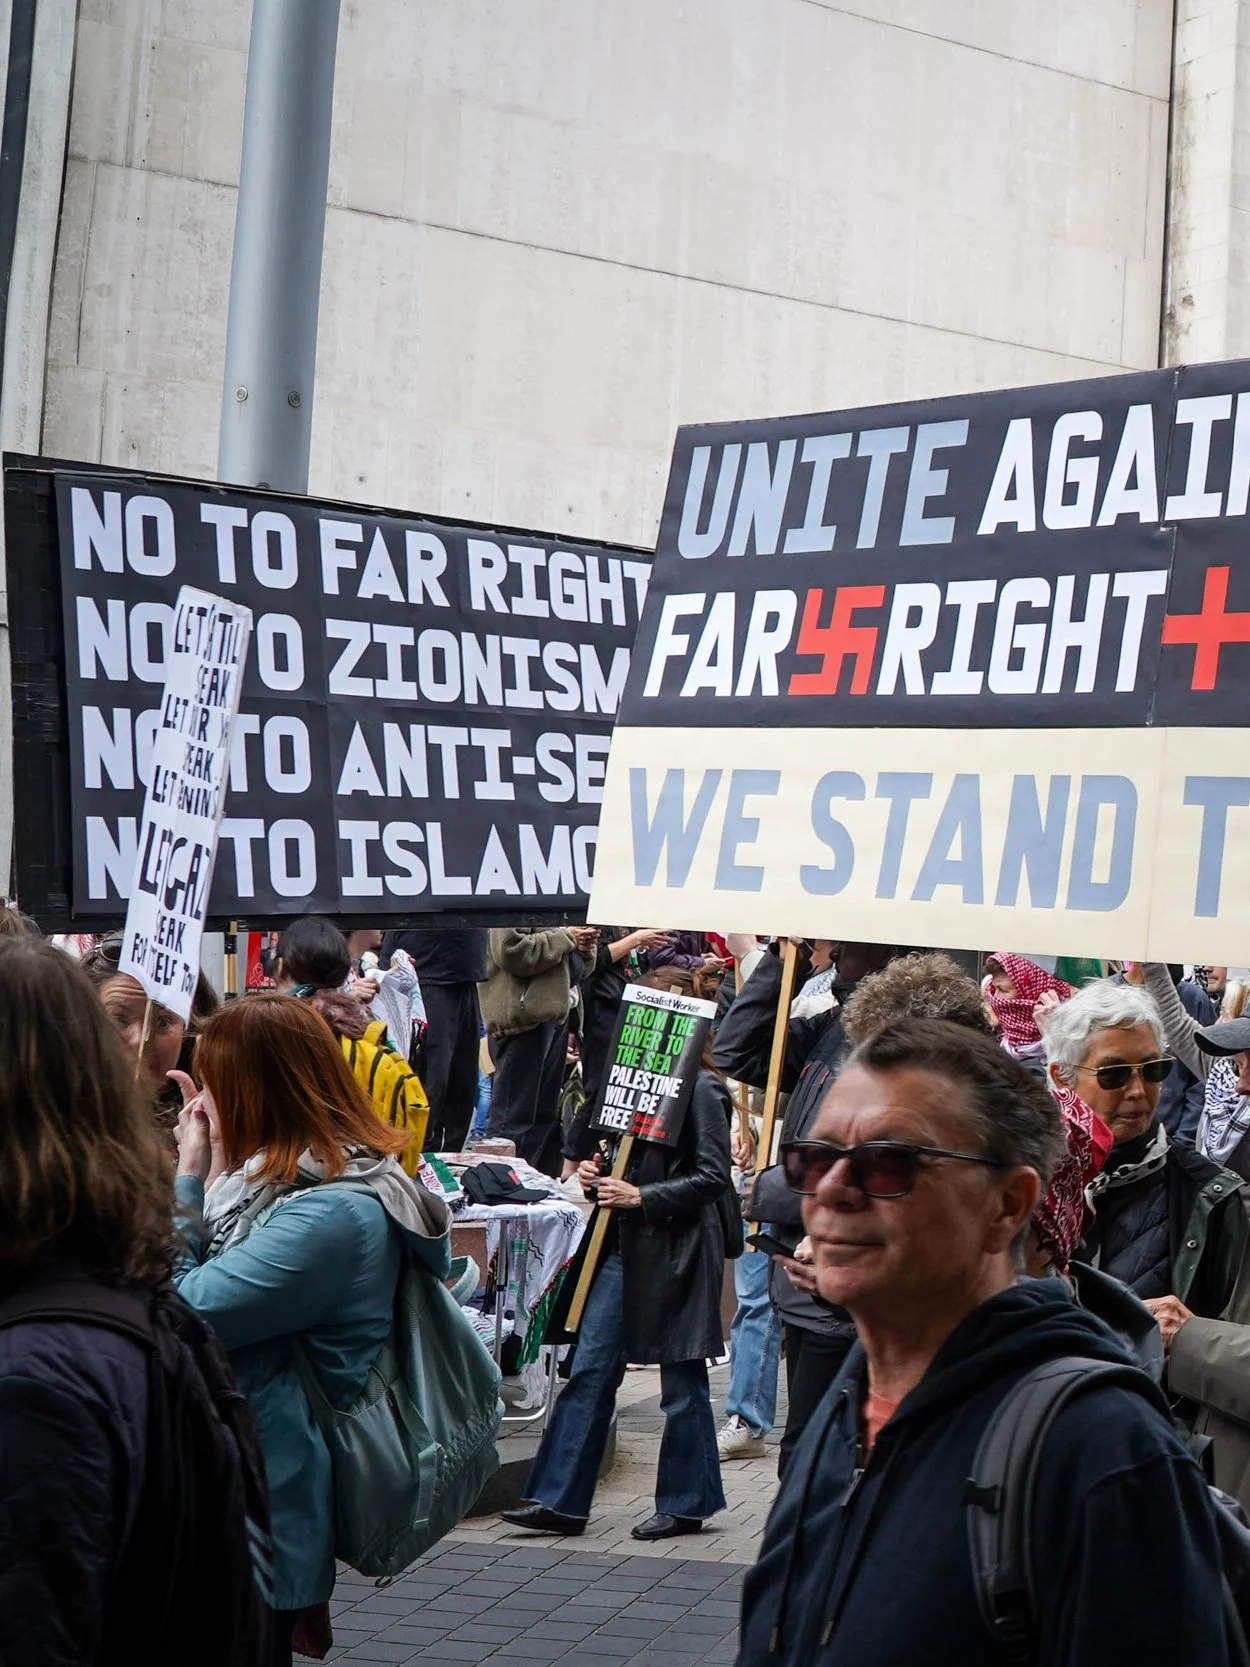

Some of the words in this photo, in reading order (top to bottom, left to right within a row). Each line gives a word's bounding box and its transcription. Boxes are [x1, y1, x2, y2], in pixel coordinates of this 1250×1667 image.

[678, 418, 970, 560] UNITE
[71, 487, 176, 577] NO
[200, 502, 299, 591] TO
[318, 517, 451, 607] FAR
[467, 538, 653, 627] RIGHT
[75, 596, 176, 683] NO
[249, 609, 305, 692] O
[325, 617, 631, 715] ZIONISM
[643, 590, 798, 697] FAR
[876, 569, 1168, 696] RIGHT
[230, 713, 312, 794] TO
[86, 816, 138, 900] N
[219, 817, 317, 898] TO
[628, 766, 781, 893] WE
[800, 770, 1139, 913] STAND
[625, 1004, 669, 1031] FROM
[671, 1014, 699, 1037] THE
[636, 991, 672, 1006] Socialist
[673, 999, 702, 1013] Worker
[615, 1044, 643, 1068] THE
[643, 1051, 672, 1075] SEA
[619, 1024, 663, 1051] RIVER
[666, 1033, 684, 1056] TO
[604, 1084, 635, 1110] WILL
[637, 1092, 660, 1115] BE
[608, 1064, 683, 1099] PALESTINE
[599, 1105, 632, 1130] FREE
